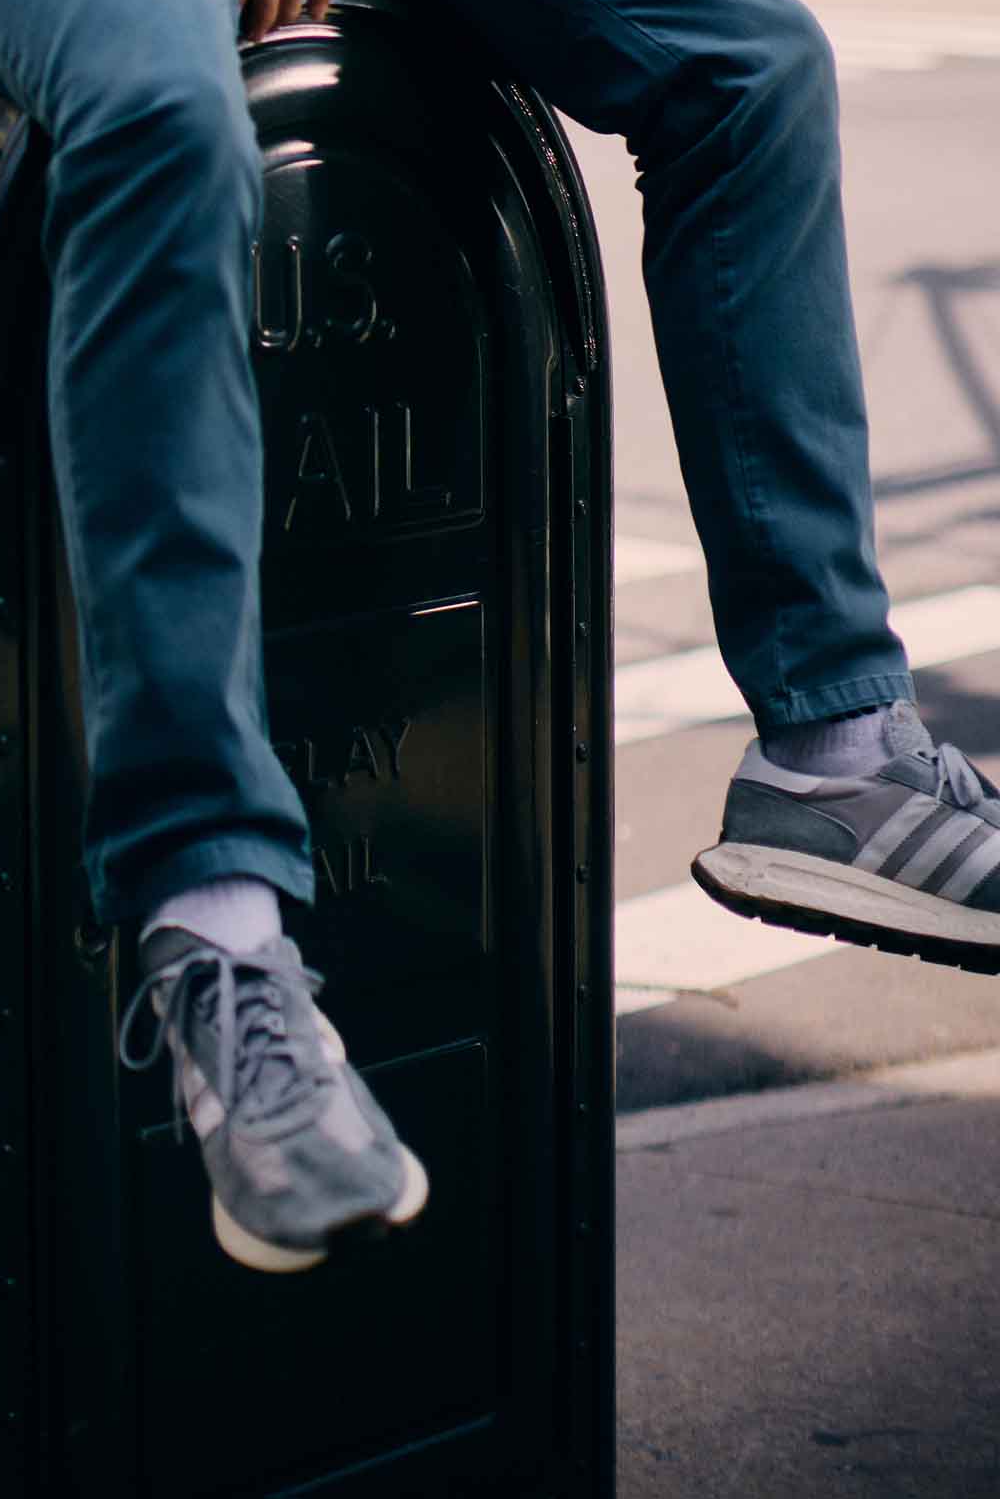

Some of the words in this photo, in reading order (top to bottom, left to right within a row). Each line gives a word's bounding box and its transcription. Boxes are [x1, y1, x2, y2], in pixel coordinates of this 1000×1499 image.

[250, 234, 398, 353] U.S.
[284, 400, 455, 532] AIL
[276, 716, 416, 788] LAY
